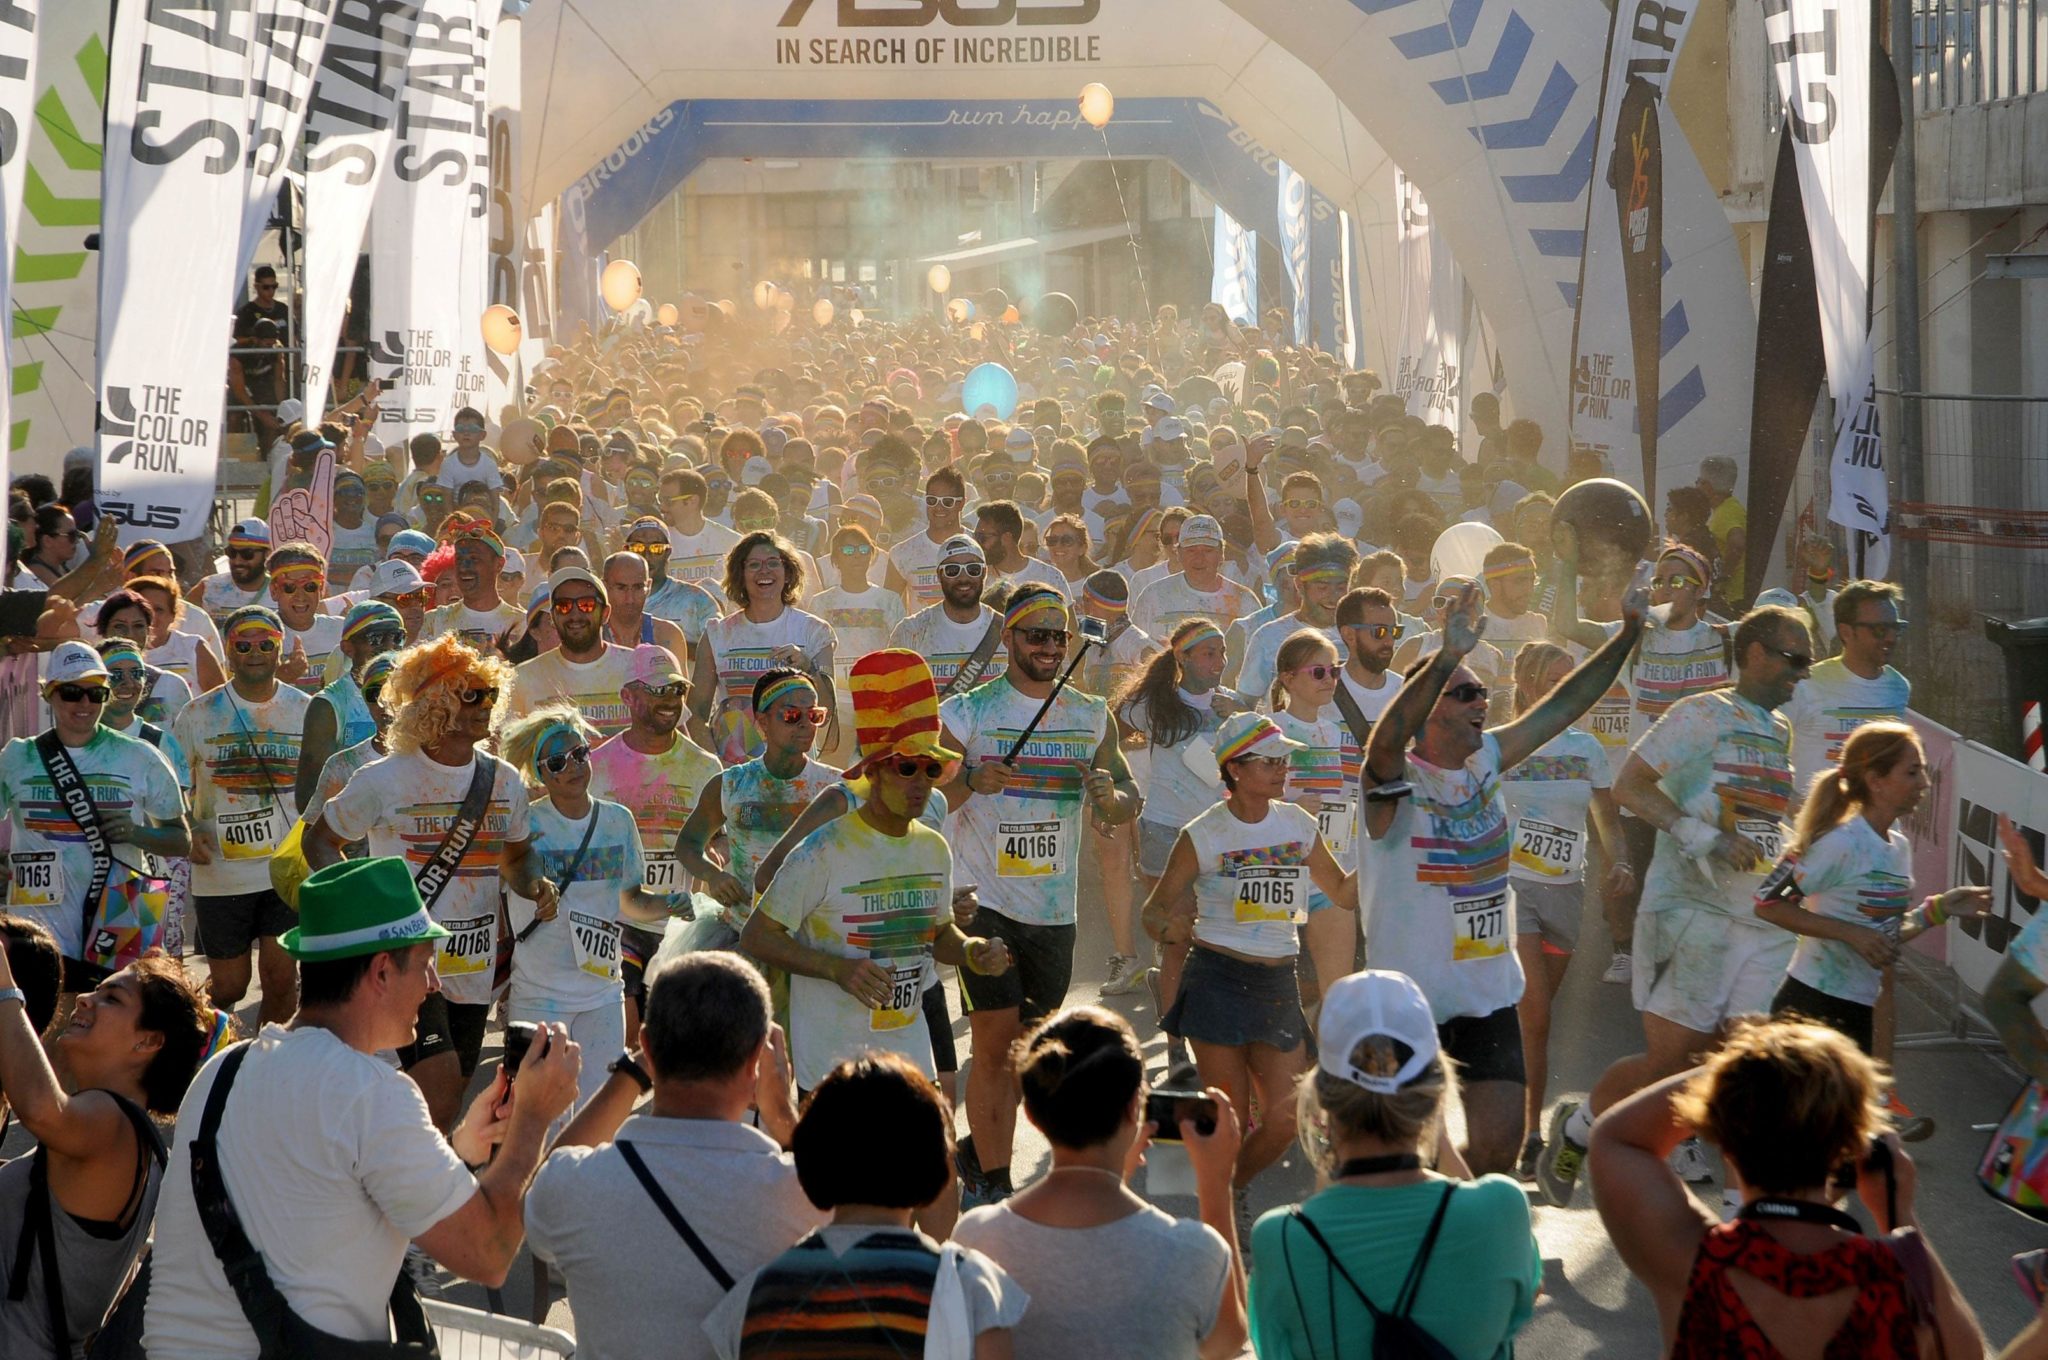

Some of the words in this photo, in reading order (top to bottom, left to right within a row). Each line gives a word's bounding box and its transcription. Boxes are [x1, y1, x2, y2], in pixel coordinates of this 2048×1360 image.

[776, 38, 800, 64] IN
[808, 37, 906, 64] SEARCH
[915, 37, 946, 63] OF
[954, 35, 1101, 63] INCREDIBLE
[577, 108, 675, 200] BROOKS
[407, 329, 433, 348] THE
[405, 349, 451, 368] COLOR
[1592, 353, 1614, 376] THE
[456, 373, 485, 393] OLOR
[1590, 375, 1631, 400] COLOR
[142, 384, 182, 416] THE
[137, 413, 209, 447] COLOR
[98, 501, 183, 530] SUS
[727, 657, 747, 671] THE
[931, 664, 949, 677] THE
[1643, 662, 1660, 680] THE
[1695, 661, 1717, 678] RUN
[607, 705, 630, 720] RUN
[1021, 741, 1063, 757] COLOR
[1064, 743, 1088, 758] RUN
[31, 785, 54, 801] THE
[100, 786, 121, 802] RUN
[48, 751, 78, 788] THE
[65, 788, 105, 855] COLOR
[225, 819, 273, 846] 40161
[414, 816, 441, 834] THE
[487, 814, 509, 833] RUN
[1004, 834, 1057, 860] 40166
[1519, 832, 1573, 864] 28733
[14, 864, 51, 889] 0163
[861, 894, 886, 913] THE
[887, 890, 924, 912] COLOR
[1239, 881, 1295, 906] 40165
[1467, 909, 1504, 942] 1277
[445, 928, 492, 958] 40168
[1756, 1201, 1800, 1217] Canon
